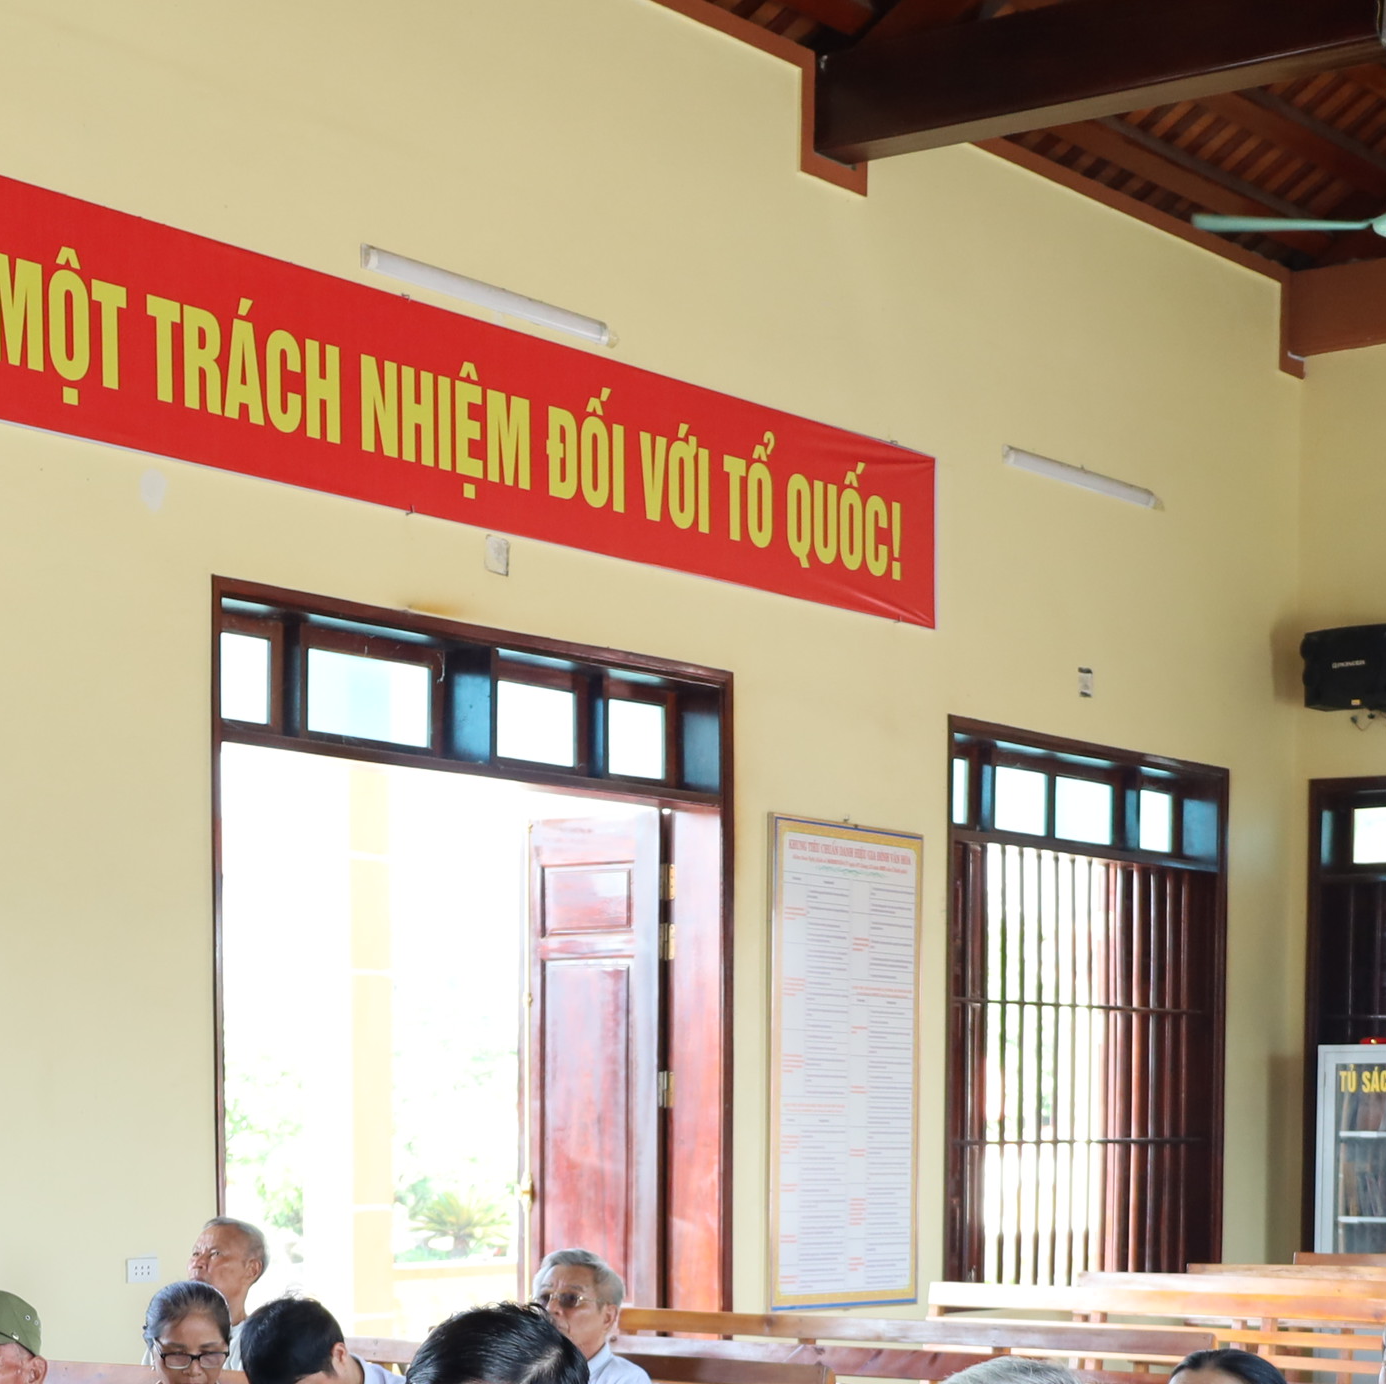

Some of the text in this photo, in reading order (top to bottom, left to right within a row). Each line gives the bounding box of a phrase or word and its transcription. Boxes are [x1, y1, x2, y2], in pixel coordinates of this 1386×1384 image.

[146, 297, 341, 444] TRÁCH
[360, 361, 531, 499] NHIỆM
[546, 387, 625, 513] ĐỐI
[639, 423, 710, 534] VỚI
[723, 431, 775, 548] TỔ
[786, 462, 902, 580] QUỐC!
[1339, 1063, 1358, 1093] TỦ
